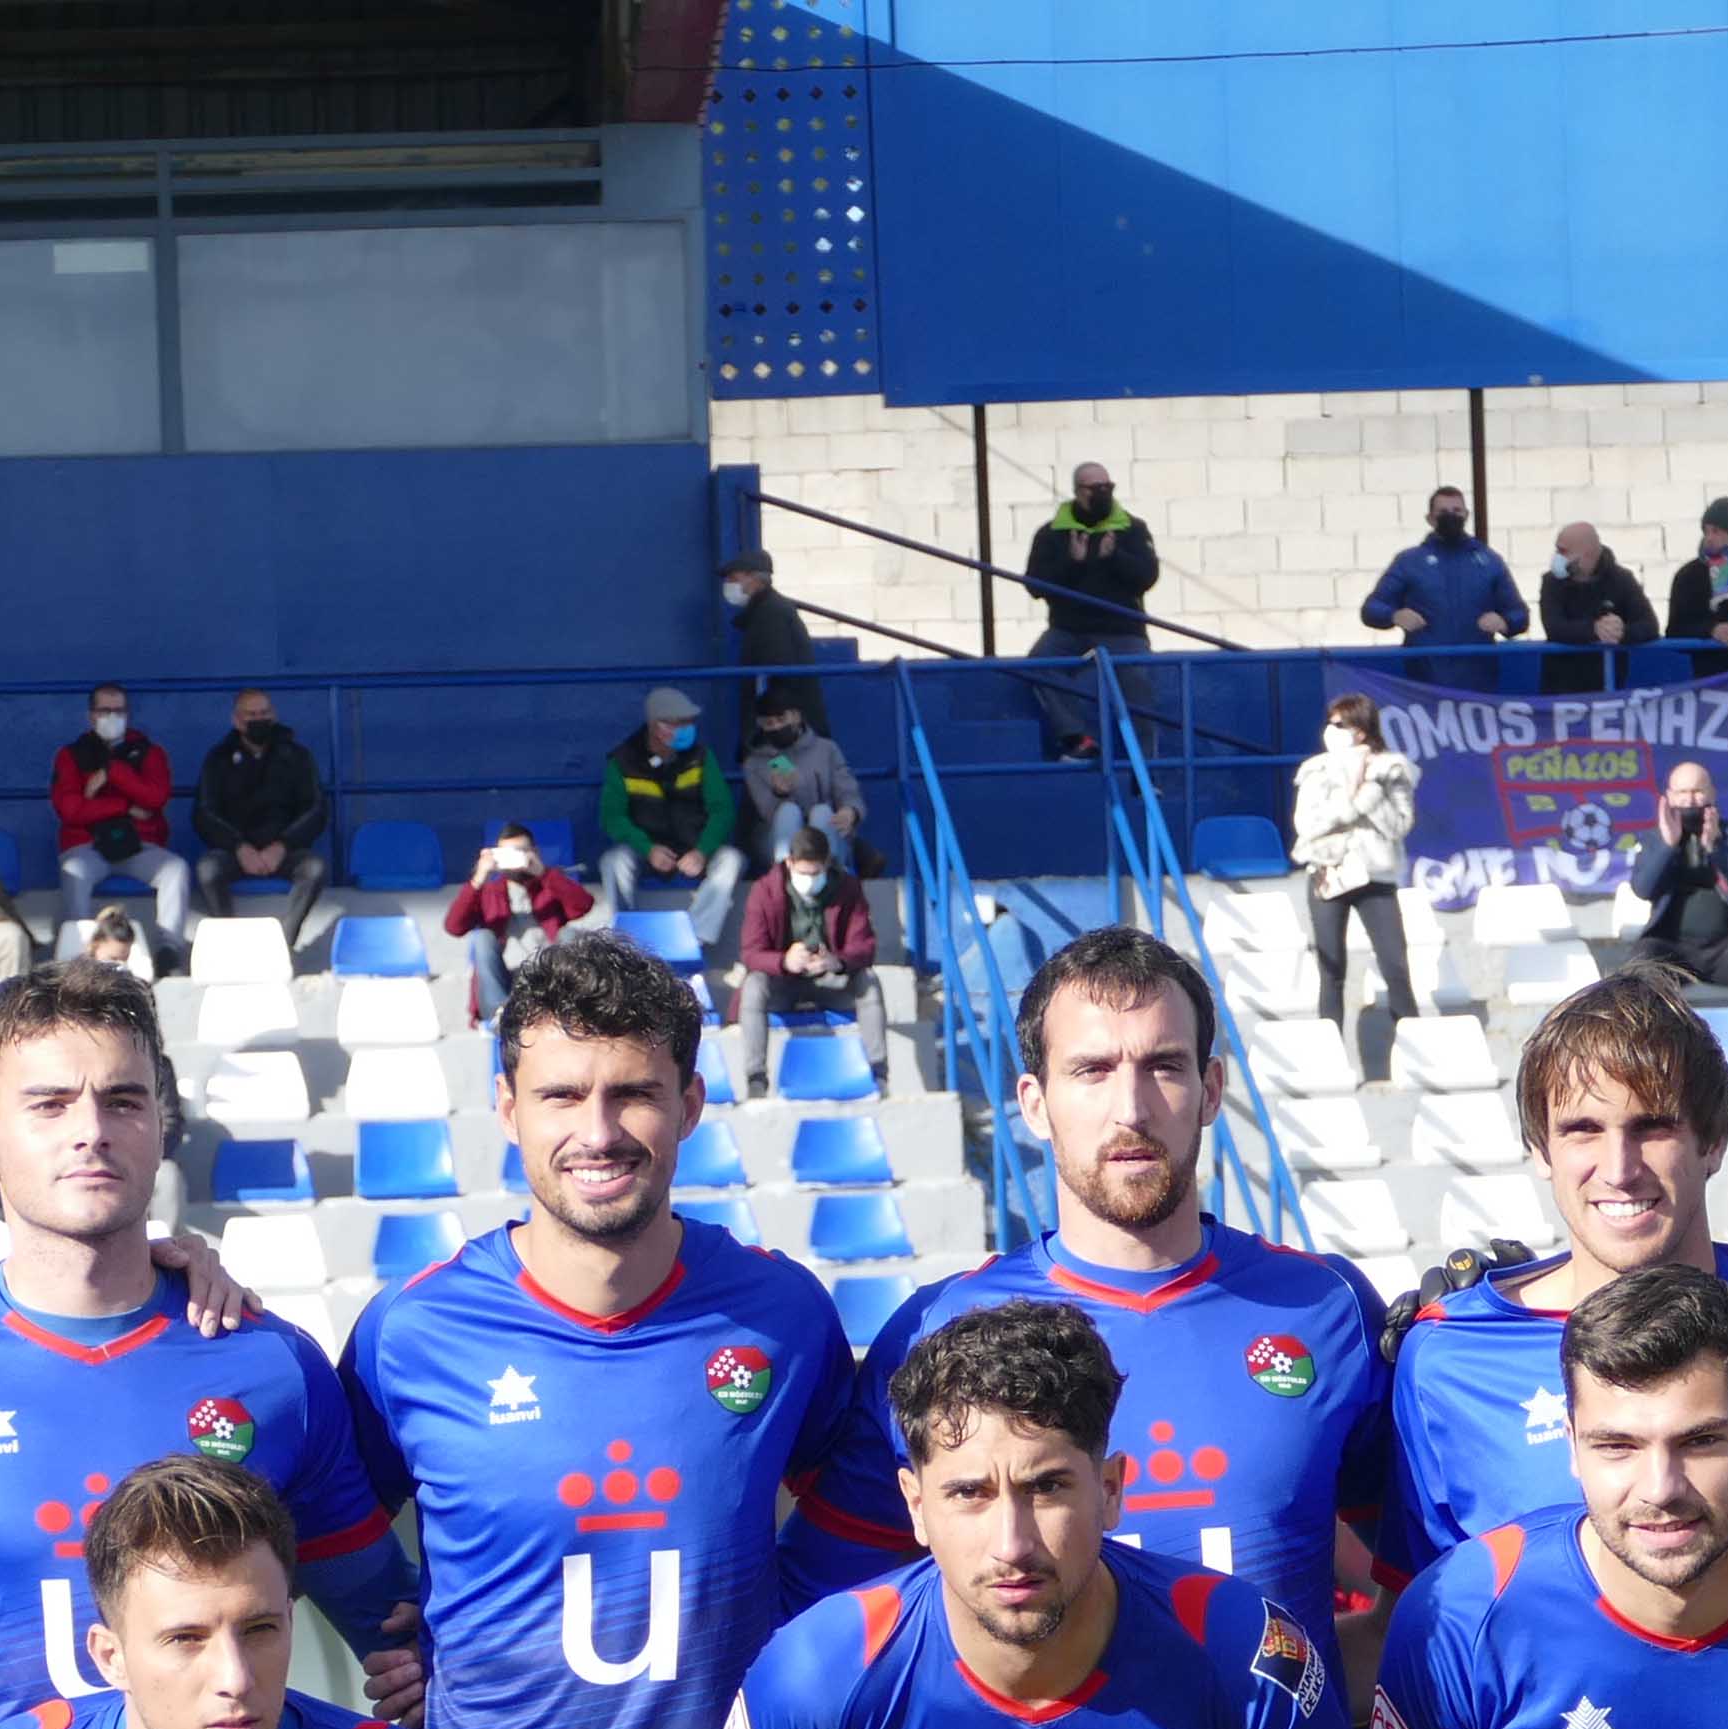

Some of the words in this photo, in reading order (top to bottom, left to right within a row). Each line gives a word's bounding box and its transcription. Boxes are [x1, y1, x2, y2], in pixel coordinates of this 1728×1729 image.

[1382, 700, 1538, 764] OMOS
[1507, 746, 1639, 783] PEÑAZOS
[489, 1406, 541, 1425] luanvi
[1526, 1428, 1566, 1446] luan
